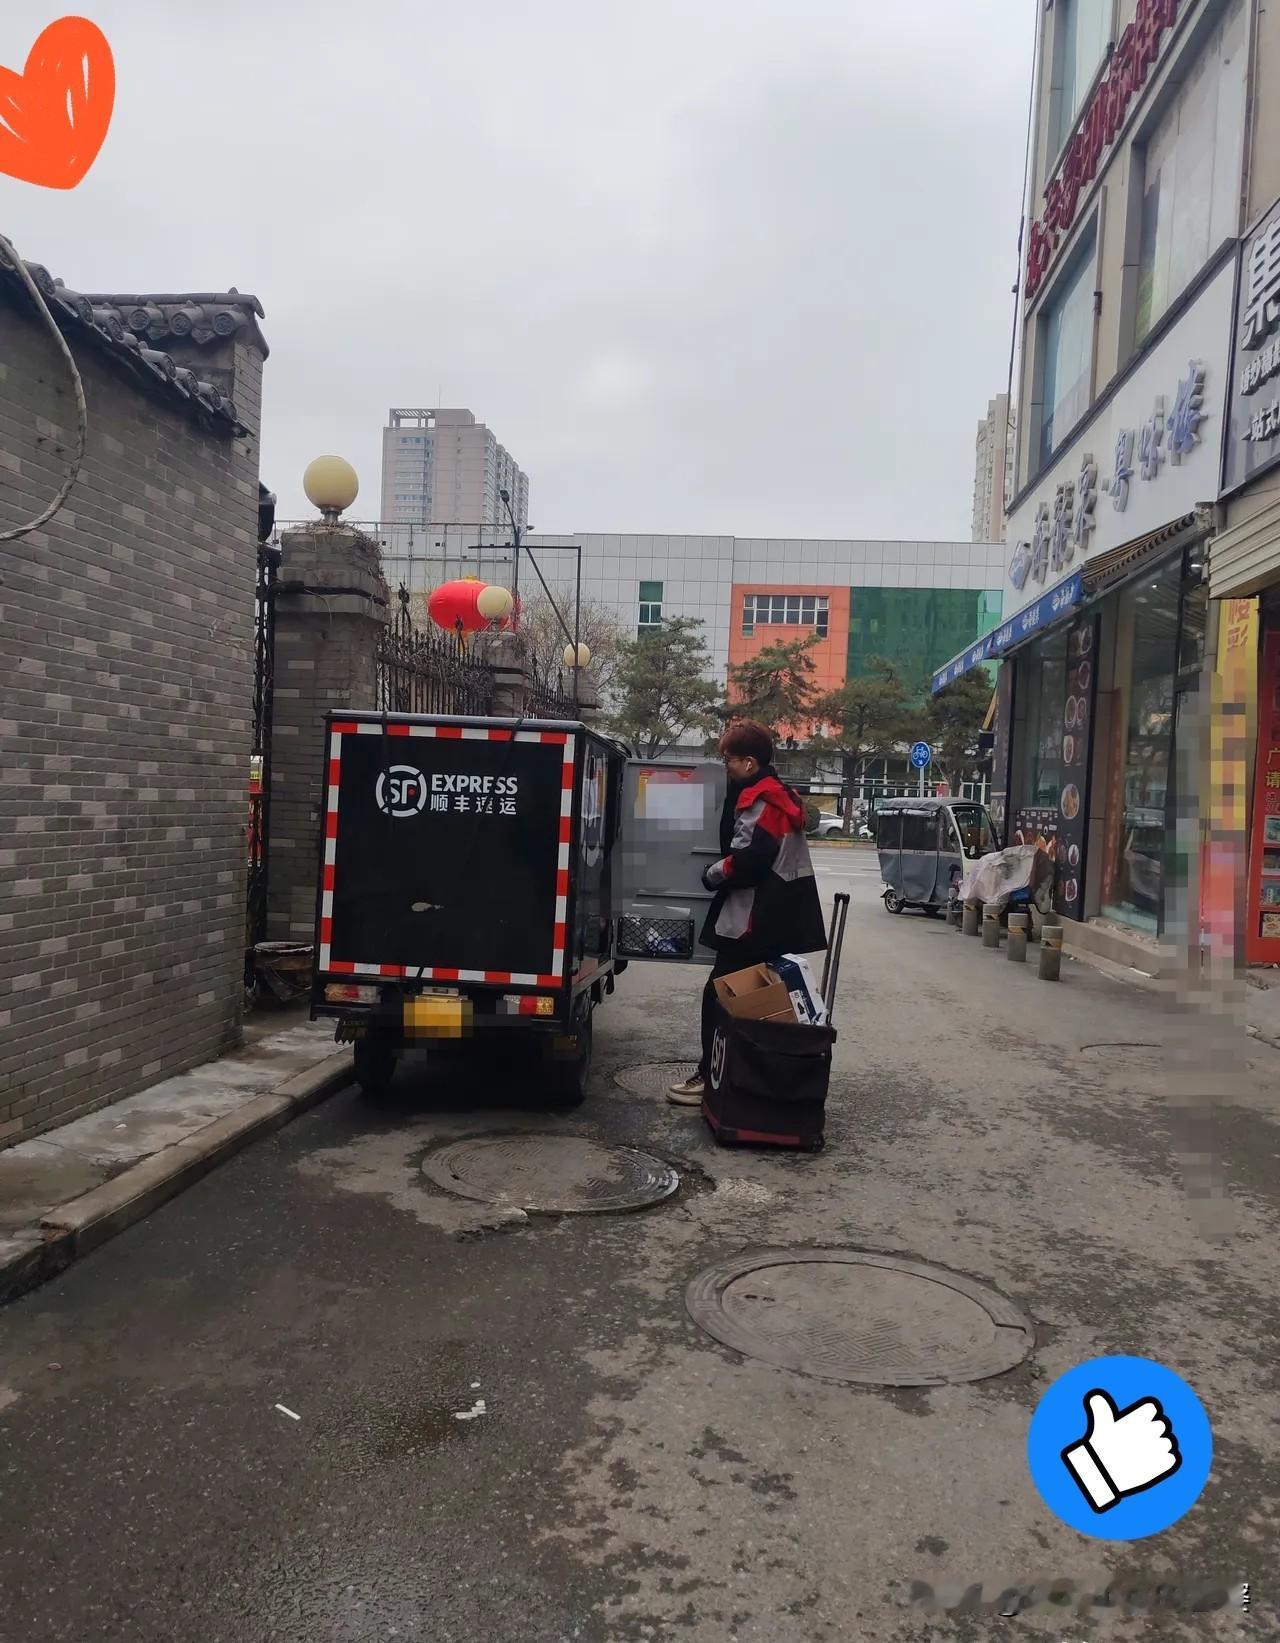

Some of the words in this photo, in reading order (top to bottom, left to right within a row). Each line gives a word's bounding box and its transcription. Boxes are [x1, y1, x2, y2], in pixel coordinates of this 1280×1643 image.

[1240, 398, 1280, 441] 一站式
[431, 774, 518, 795] EXPRESS
[430, 794, 517, 815] 顺丰速运
